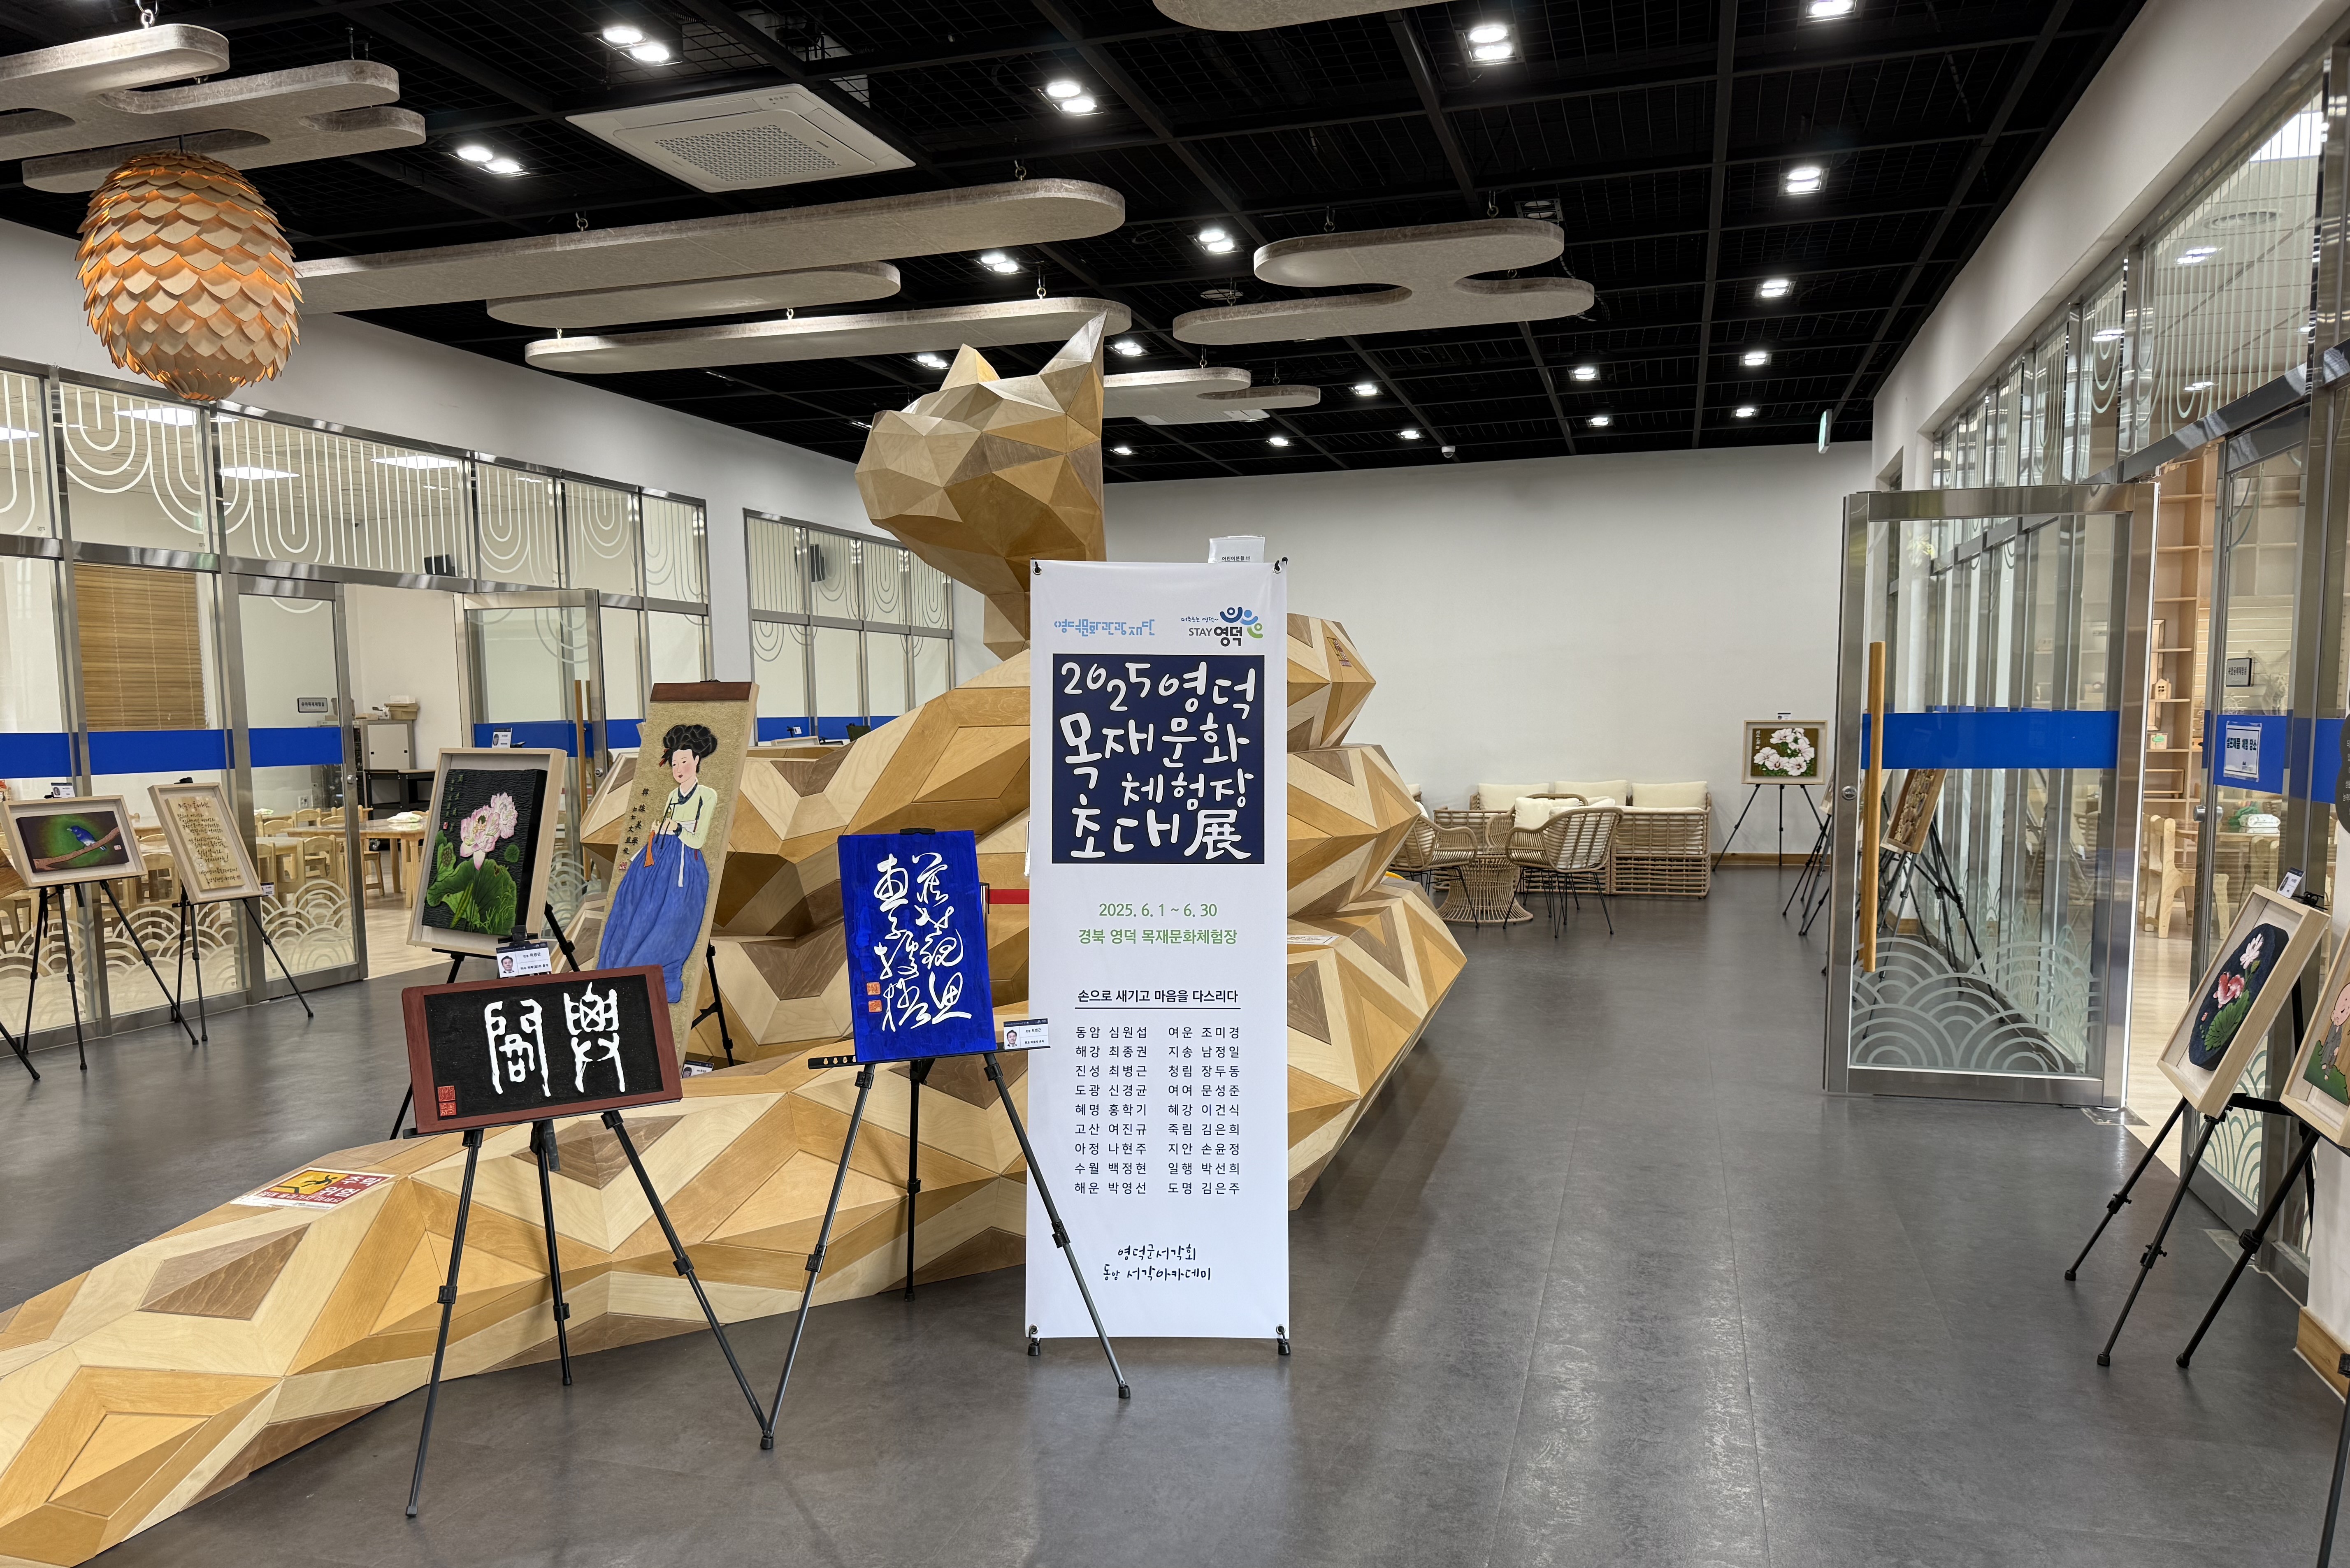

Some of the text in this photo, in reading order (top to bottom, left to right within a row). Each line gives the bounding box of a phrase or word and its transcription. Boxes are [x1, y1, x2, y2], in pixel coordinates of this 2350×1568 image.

[1189, 626, 1242, 647] STAY 영덕
[2250, 739, 2257, 751] 장소
[1122, 768, 1254, 810] 체험장
[1099, 903, 1137, 917] 2025.
[1141, 903, 1153, 917] 6.
[1183, 903, 1196, 917] 6.
[1200, 903, 1217, 917] 30
[1078, 929, 1238, 944] 경북 영덕 목재문화체험장
[1077, 990, 1238, 1003] 손으로 새기고 마음을 다스리다
[1076, 1026, 1146, 1039] 동암 심원섭
[1168, 1026, 1239, 1039] 여운 조미경
[1075, 1046, 1147, 1058] 해강 최종권
[1168, 1046, 1239, 1058] 지송 남정일
[1076, 1065, 1147, 1077] 진성 최병근
[1168, 1065, 1240, 1078] 청림 장두동
[1075, 1084, 1147, 1097] 도광 신경균
[1168, 1084, 1240, 1097] 여여 문성준
[1075, 1104, 1146, 1116] 혜명 홍학기
[1168, 1104, 1239, 1116] 혜강 이건식
[1075, 1123, 1147, 1136] 고산 여진규
[1168, 1123, 1239, 1136] 죽림 김은희
[1075, 1143, 1147, 1155] 아정 나현주
[1168, 1143, 1239, 1155] 지안 손윤정
[1075, 1162, 1146, 1175] 수월 백정현
[1168, 1162, 1239, 1175] 일행 박선희
[341, 1176, 382, 1187] 추락
[319, 1187, 361, 1197] 위험
[1075, 1182, 1146, 1195] 해운 박영선
[1168, 1182, 1240, 1195] 도명 김은주
[1118, 1243, 1196, 1261] 영덕군서각회
[1127, 1265, 1210, 1281] 서각아카데미
